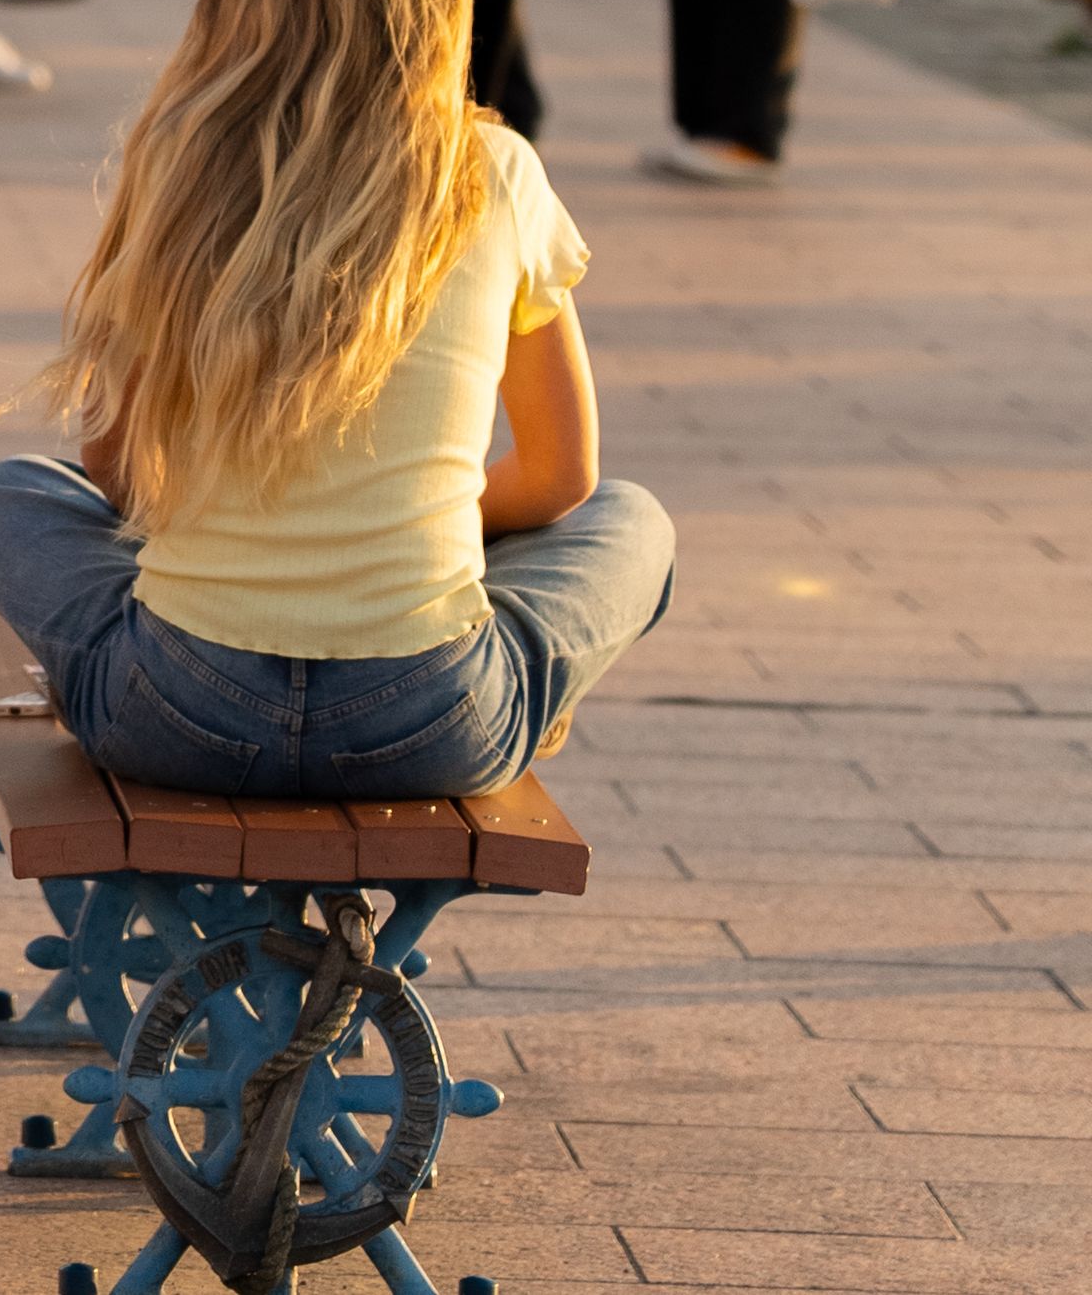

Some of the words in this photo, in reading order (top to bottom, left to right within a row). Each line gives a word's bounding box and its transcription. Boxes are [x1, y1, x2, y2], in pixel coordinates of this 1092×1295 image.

[127, 977, 198, 1077] PORT
[198, 941, 251, 992] OF
[375, 996, 440, 1190] HAKODATE
